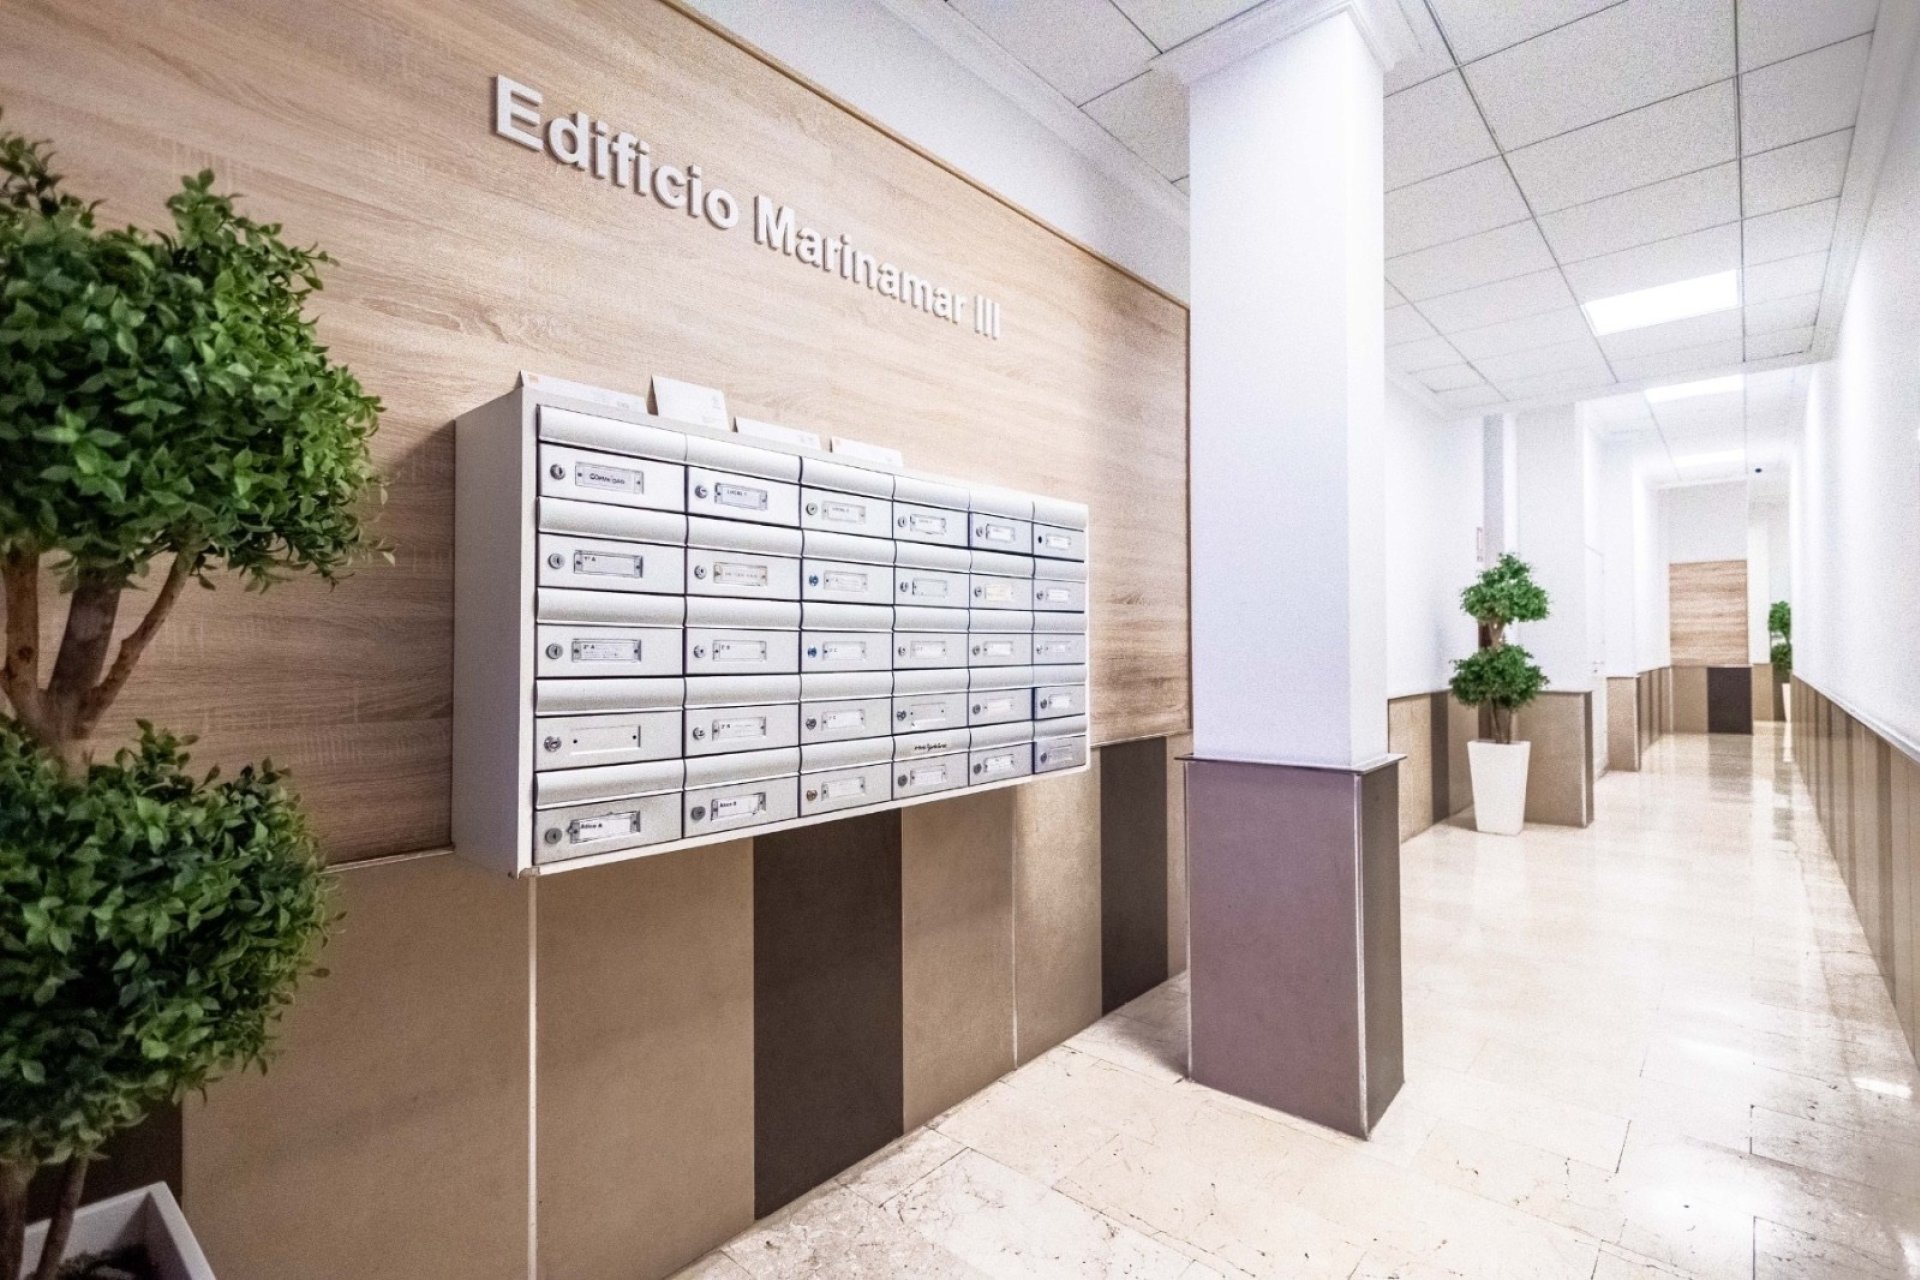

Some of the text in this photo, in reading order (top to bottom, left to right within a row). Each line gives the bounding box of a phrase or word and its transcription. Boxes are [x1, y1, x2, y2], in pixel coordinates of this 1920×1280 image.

[494, 74, 1000, 340] Edificio Marinamar III
